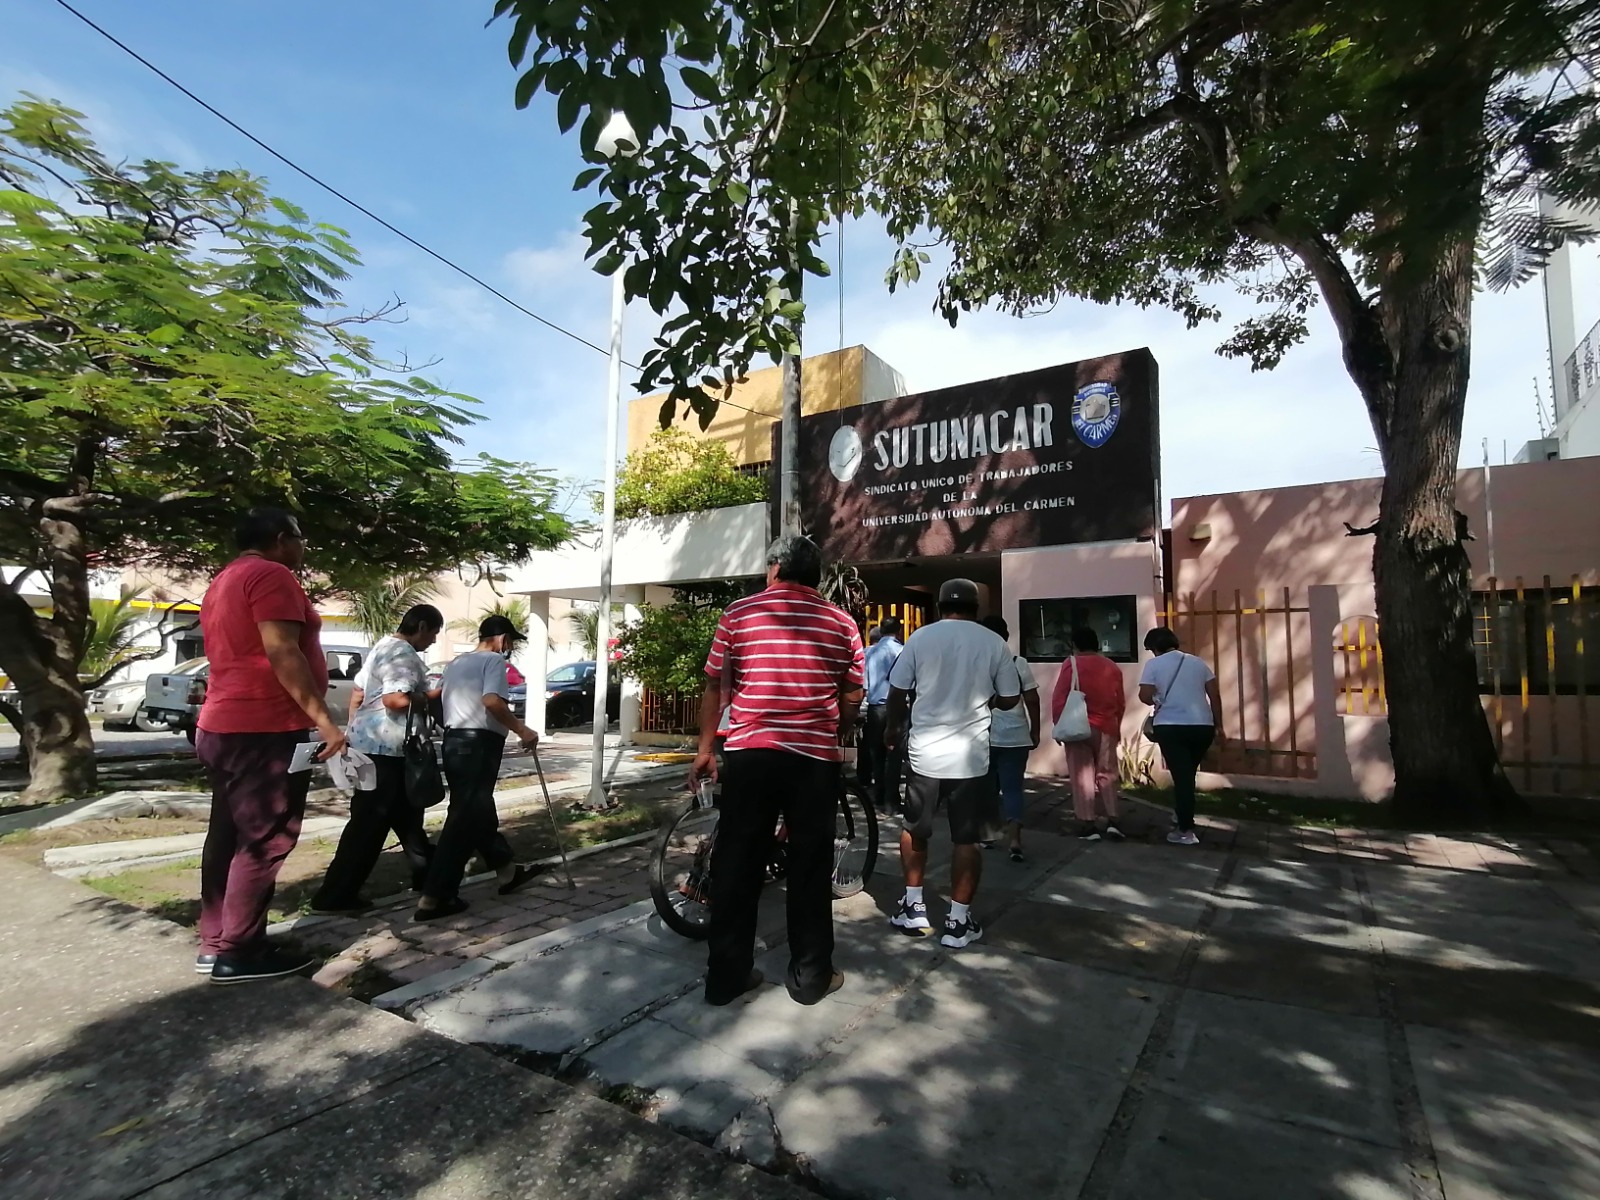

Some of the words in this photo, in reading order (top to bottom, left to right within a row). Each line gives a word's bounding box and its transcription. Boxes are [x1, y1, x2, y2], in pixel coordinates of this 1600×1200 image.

[873, 403, 1053, 471] SUTUNACAR
[864, 481, 917, 496] SINDICATO
[921, 476, 954, 489] UNICO
[958, 473, 973, 484] DE
[979, 460, 1073, 482] TRABAJADORES
[862, 511, 928, 527] UNIVERSIDAD
[931, 506, 991, 521] AUTONOMA
[996, 503, 1019, 514] DEL
[1023, 496, 1075, 511] CARMEN
[943, 492, 957, 503] DE
[963, 491, 977, 501] LA
